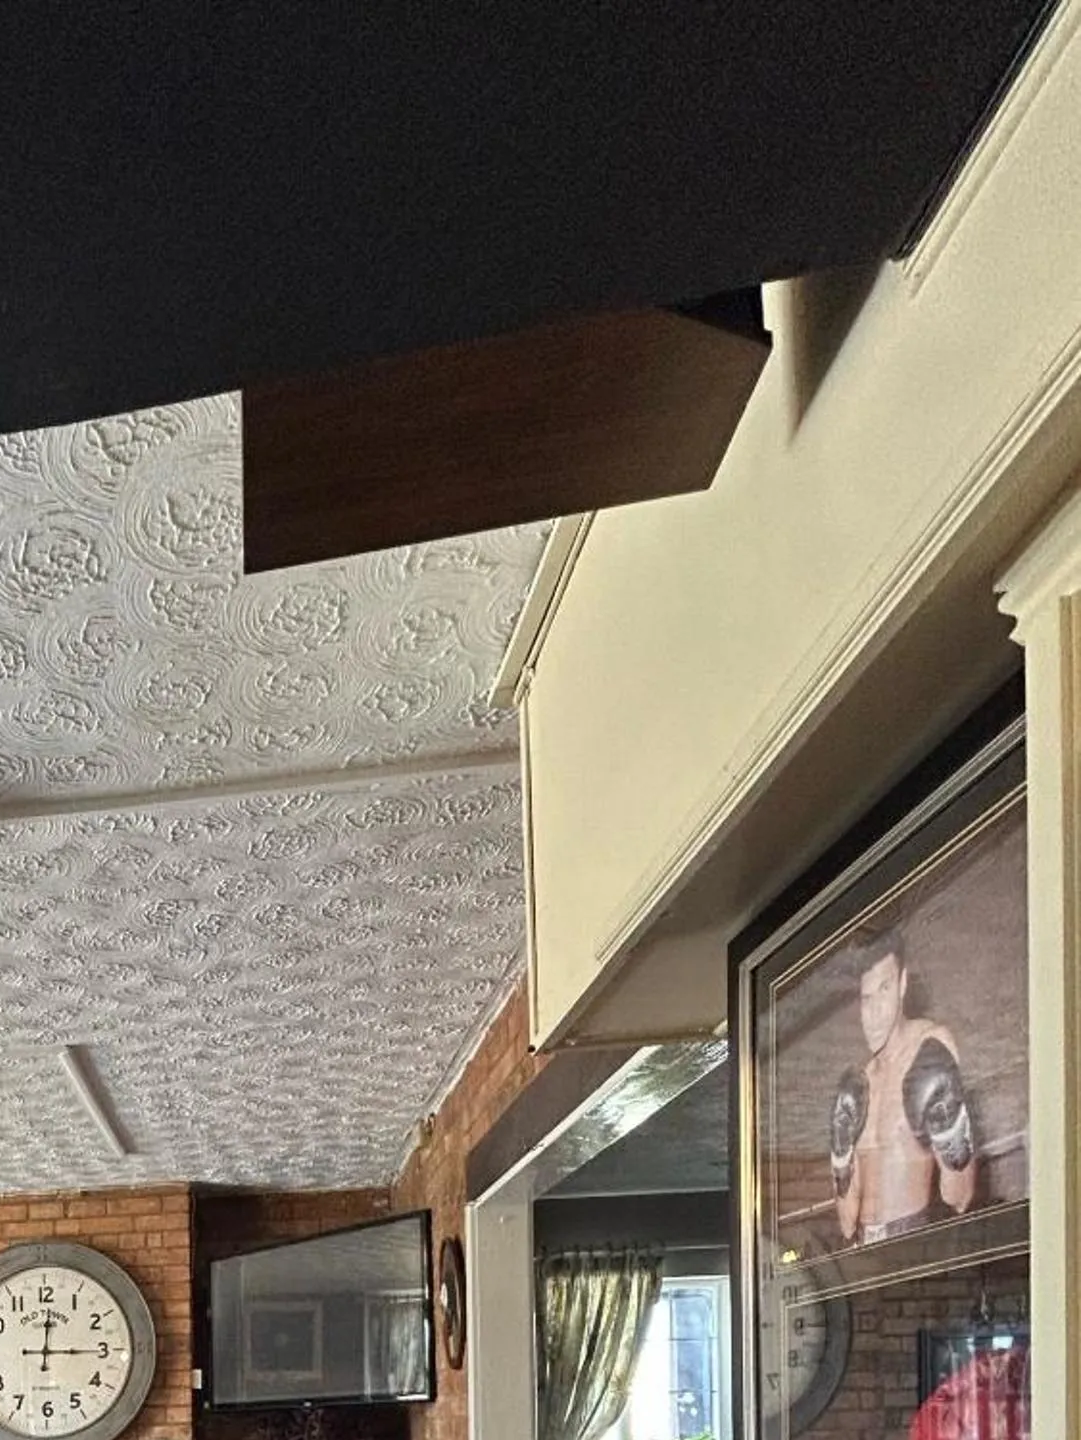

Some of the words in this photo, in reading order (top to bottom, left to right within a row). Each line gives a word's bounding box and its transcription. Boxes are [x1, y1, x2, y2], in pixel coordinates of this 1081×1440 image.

[39, 1286, 54, 1303] 12
[72, 1294, 77, 1311] 1
[12, 1295, 24, 1312] 11
[89, 1313, 102, 1330] 2
[98, 1342, 109, 1359] 3
[88, 1371, 102, 1387] 4
[12, 1394, 25, 1410] 7
[70, 1392, 81, 1409] 5
[41, 1401, 54, 1418] 6
